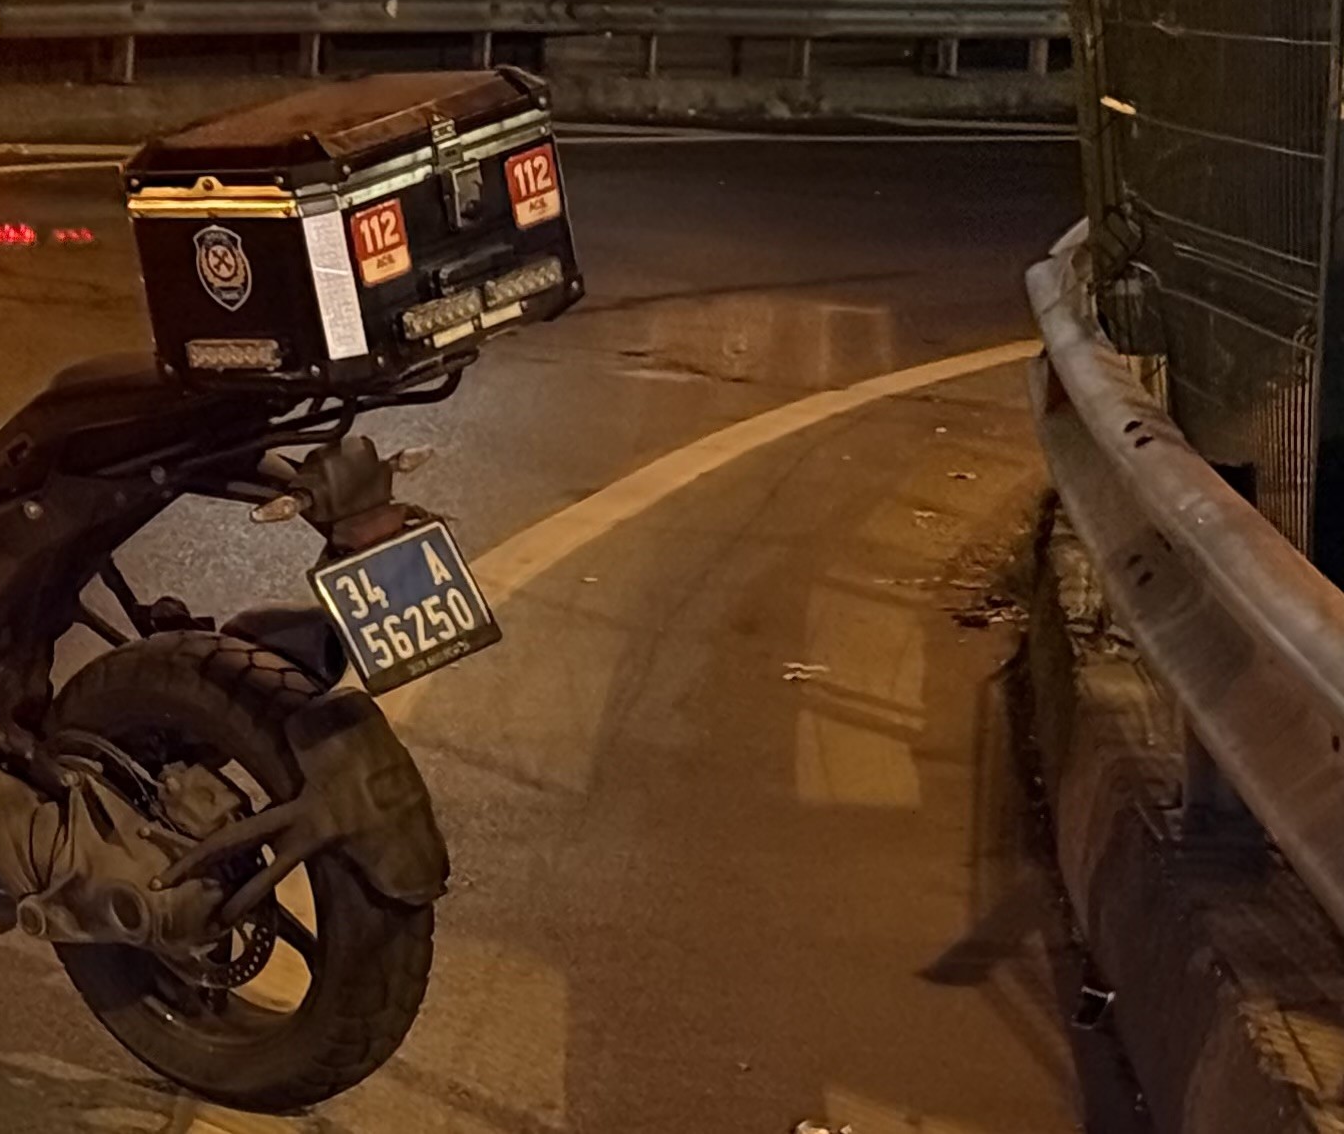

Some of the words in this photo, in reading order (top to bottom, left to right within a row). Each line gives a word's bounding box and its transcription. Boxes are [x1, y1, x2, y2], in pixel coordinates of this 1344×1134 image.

[514, 155, 552, 197] 112
[360, 210, 400, 254] 112
[336, 568, 390, 620] 34
[421, 541, 453, 585] A
[360, 588, 474, 668] 56250
